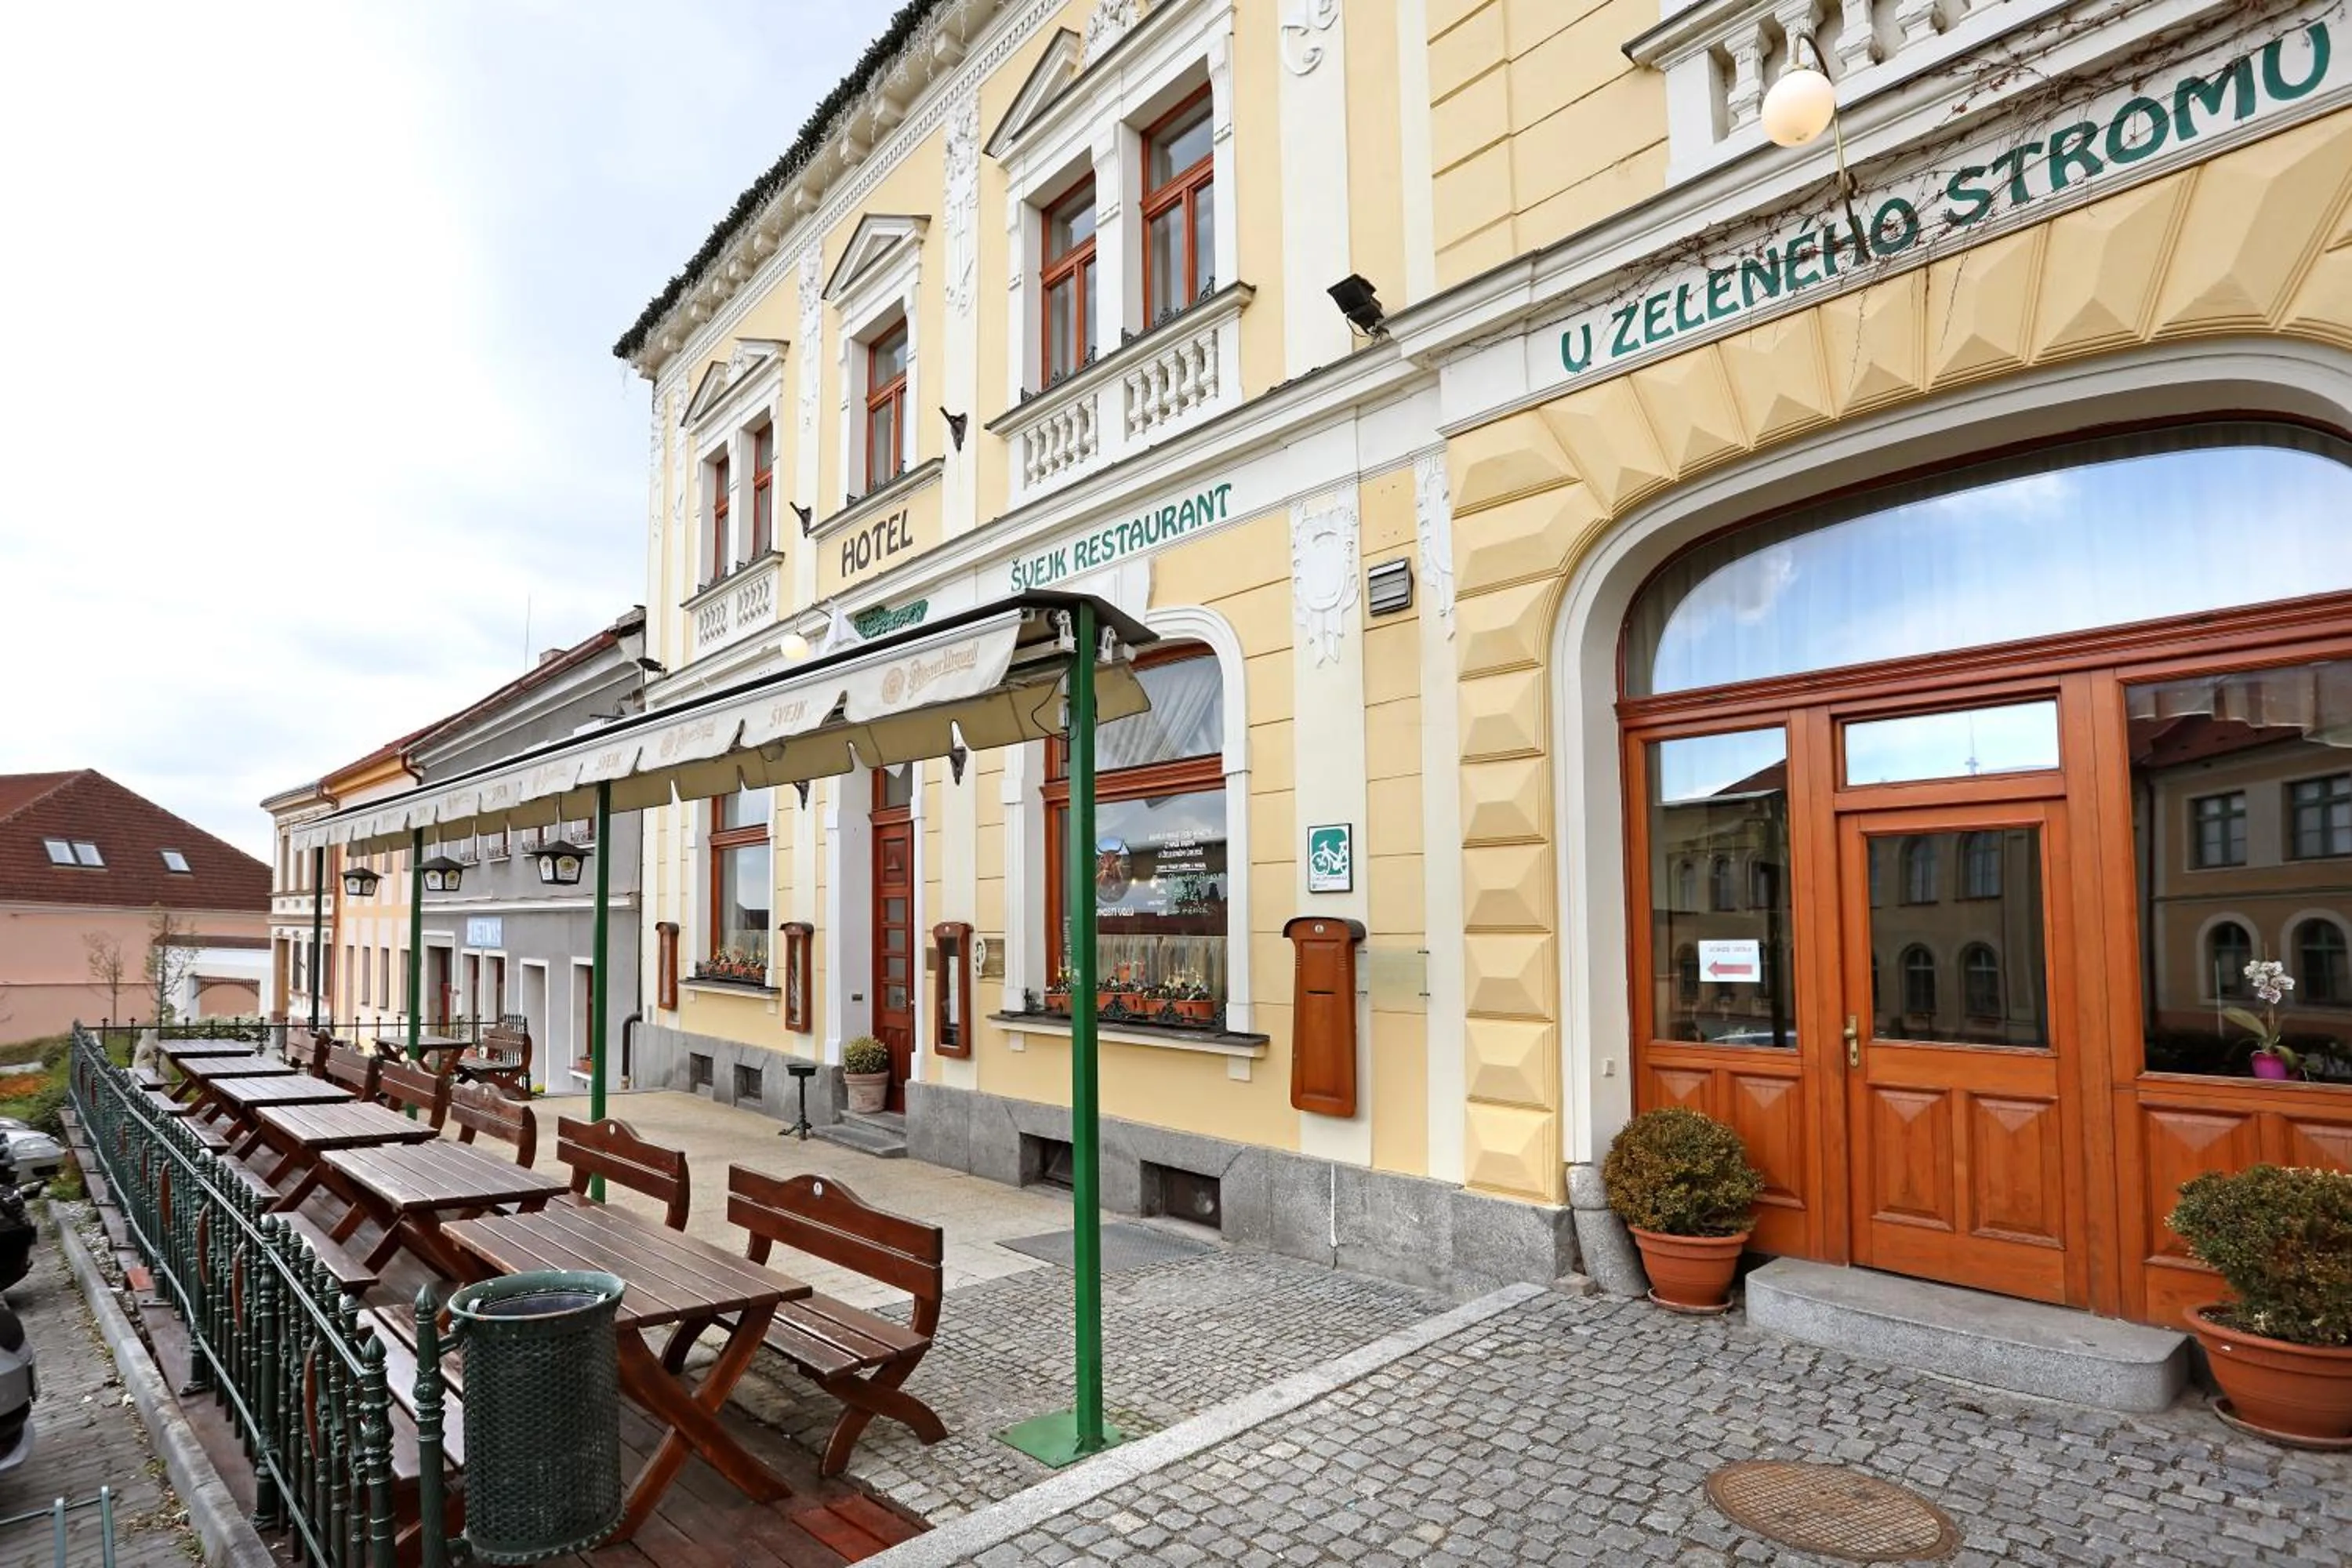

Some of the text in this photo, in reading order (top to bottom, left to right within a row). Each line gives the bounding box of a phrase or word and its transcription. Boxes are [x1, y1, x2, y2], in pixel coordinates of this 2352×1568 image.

[1559, 23, 2331, 374] U ZELENÉHO STROMU
[841, 508, 913, 578] HOTEL
[1011, 482, 1232, 592] ŠVEJK RESTAURANT
